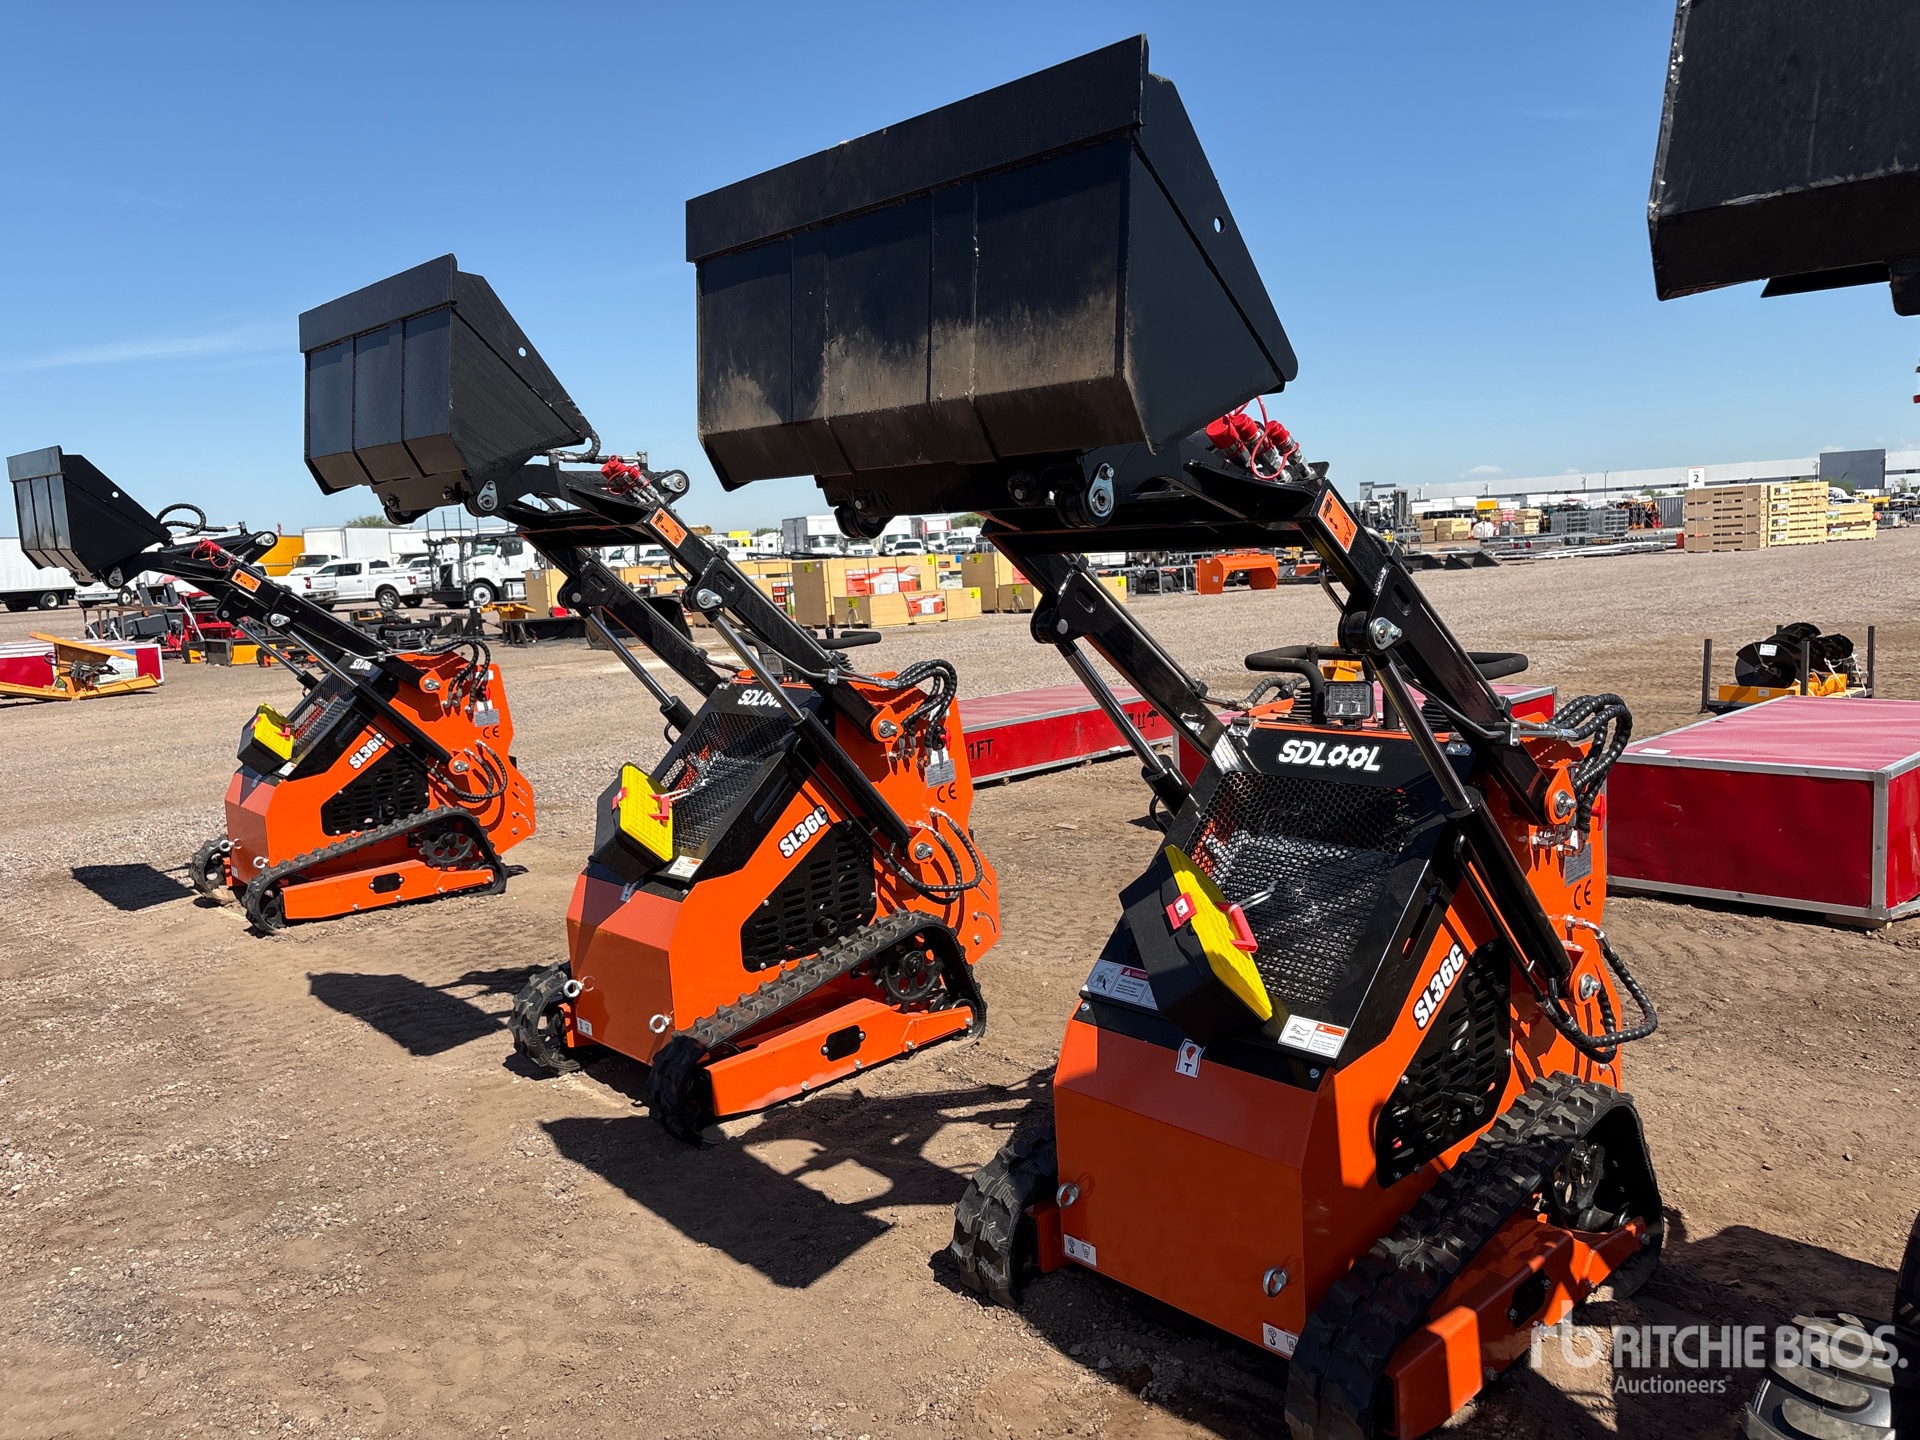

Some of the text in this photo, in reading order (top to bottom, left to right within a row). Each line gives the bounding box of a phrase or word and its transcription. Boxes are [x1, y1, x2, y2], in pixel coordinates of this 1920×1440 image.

[1693, 474, 1700, 483] 2
[349, 733, 387, 770] SL36C
[1277, 738, 1384, 772] SDLOOL
[779, 805, 828, 858] SL36C
[1412, 942, 1466, 1030] SL36C
[1184, 1061, 1193, 1073] T
